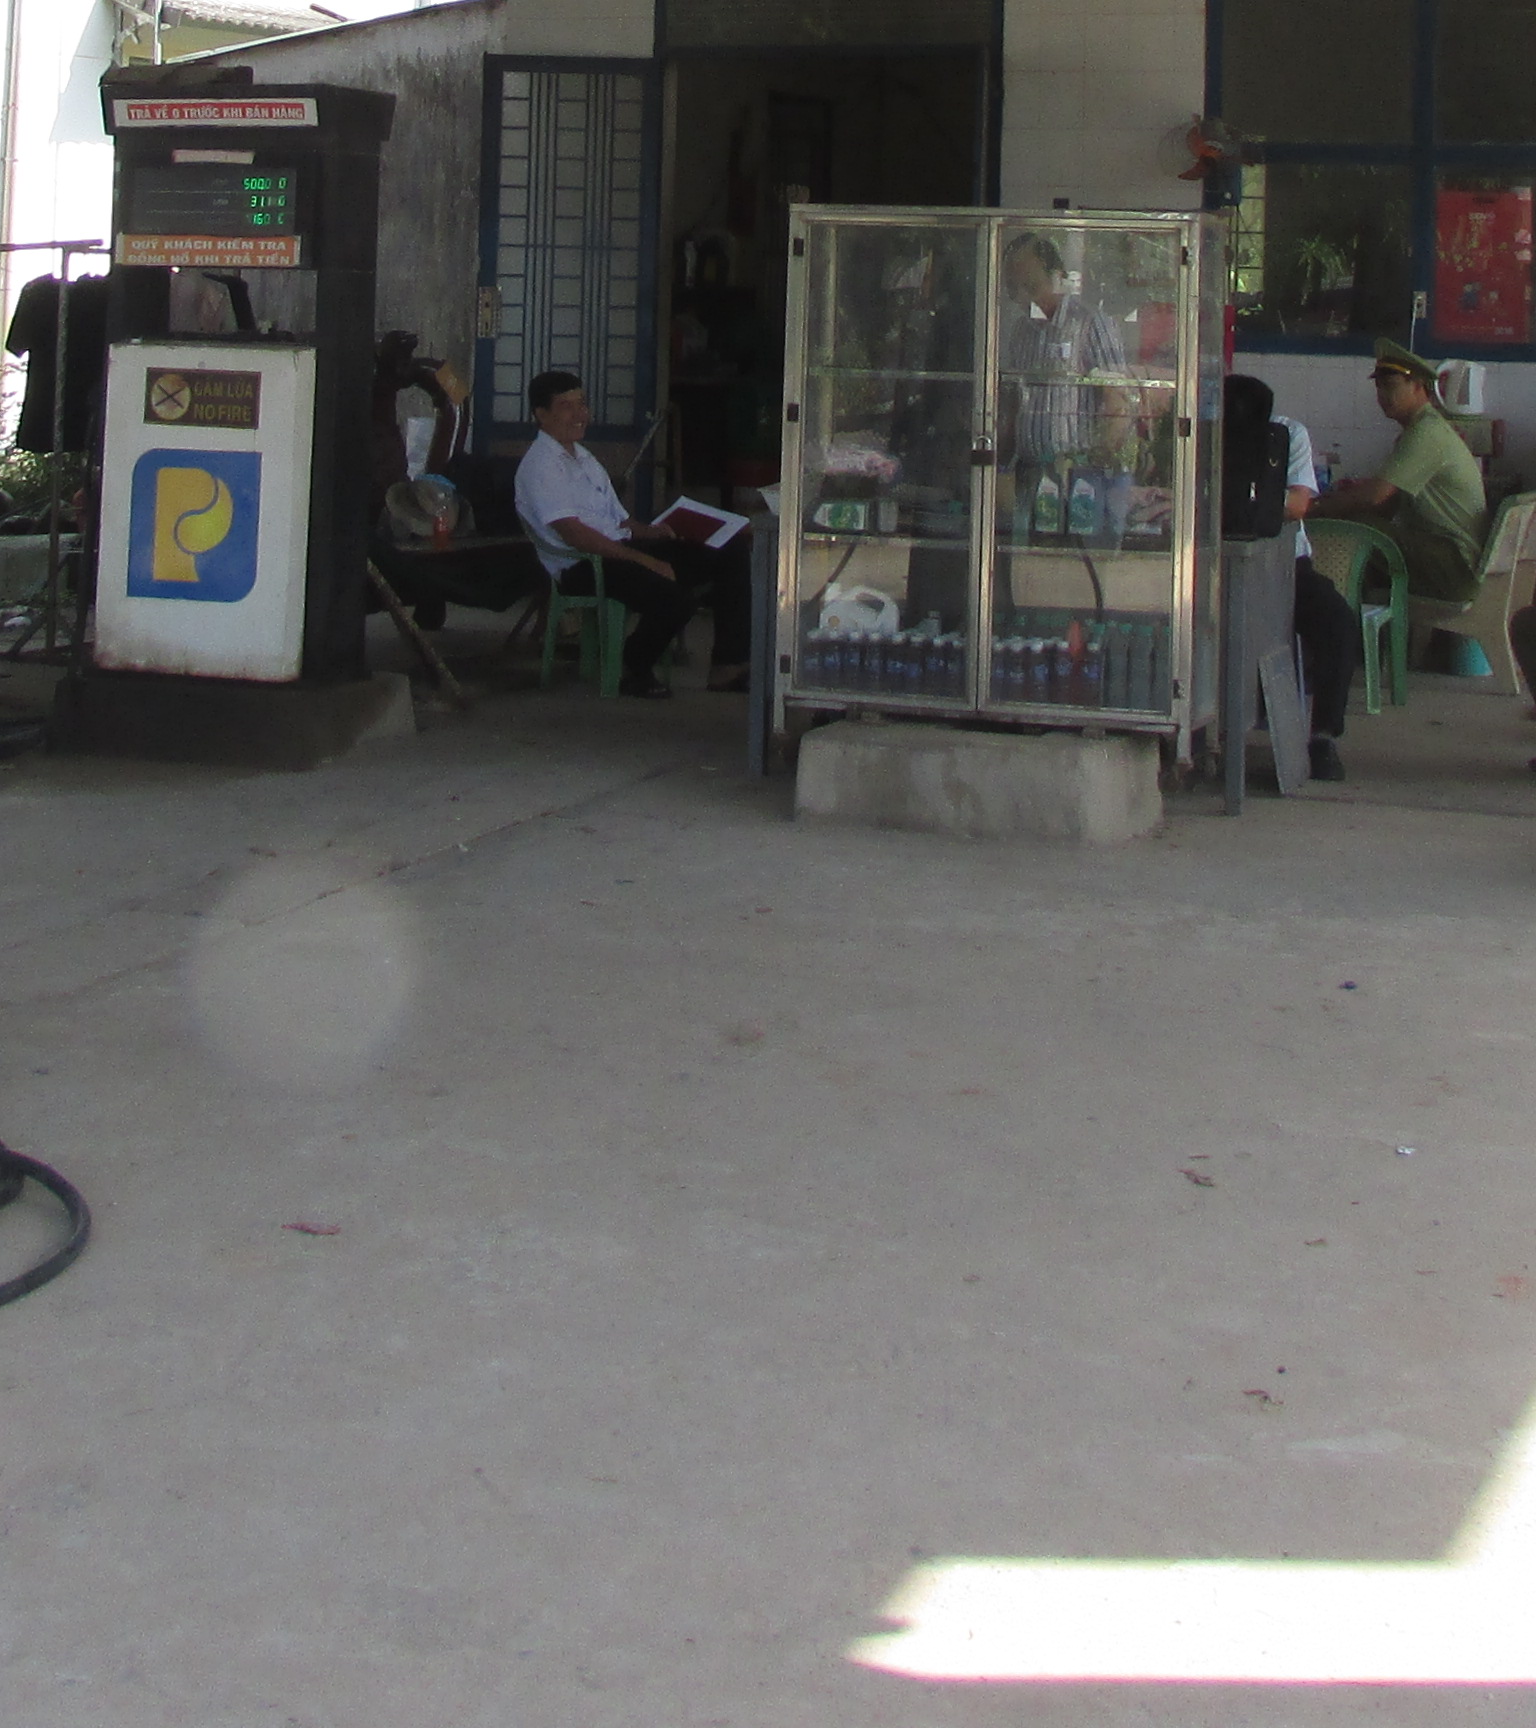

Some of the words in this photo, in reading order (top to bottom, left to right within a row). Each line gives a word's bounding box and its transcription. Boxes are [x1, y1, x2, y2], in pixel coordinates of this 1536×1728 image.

[223, 107, 242, 118] KHI
[246, 105, 269, 119] BÁN
[272, 104, 303, 119] HÀNG
[195, 403, 215, 420] NO
[218, 404, 252, 422] FIRE
